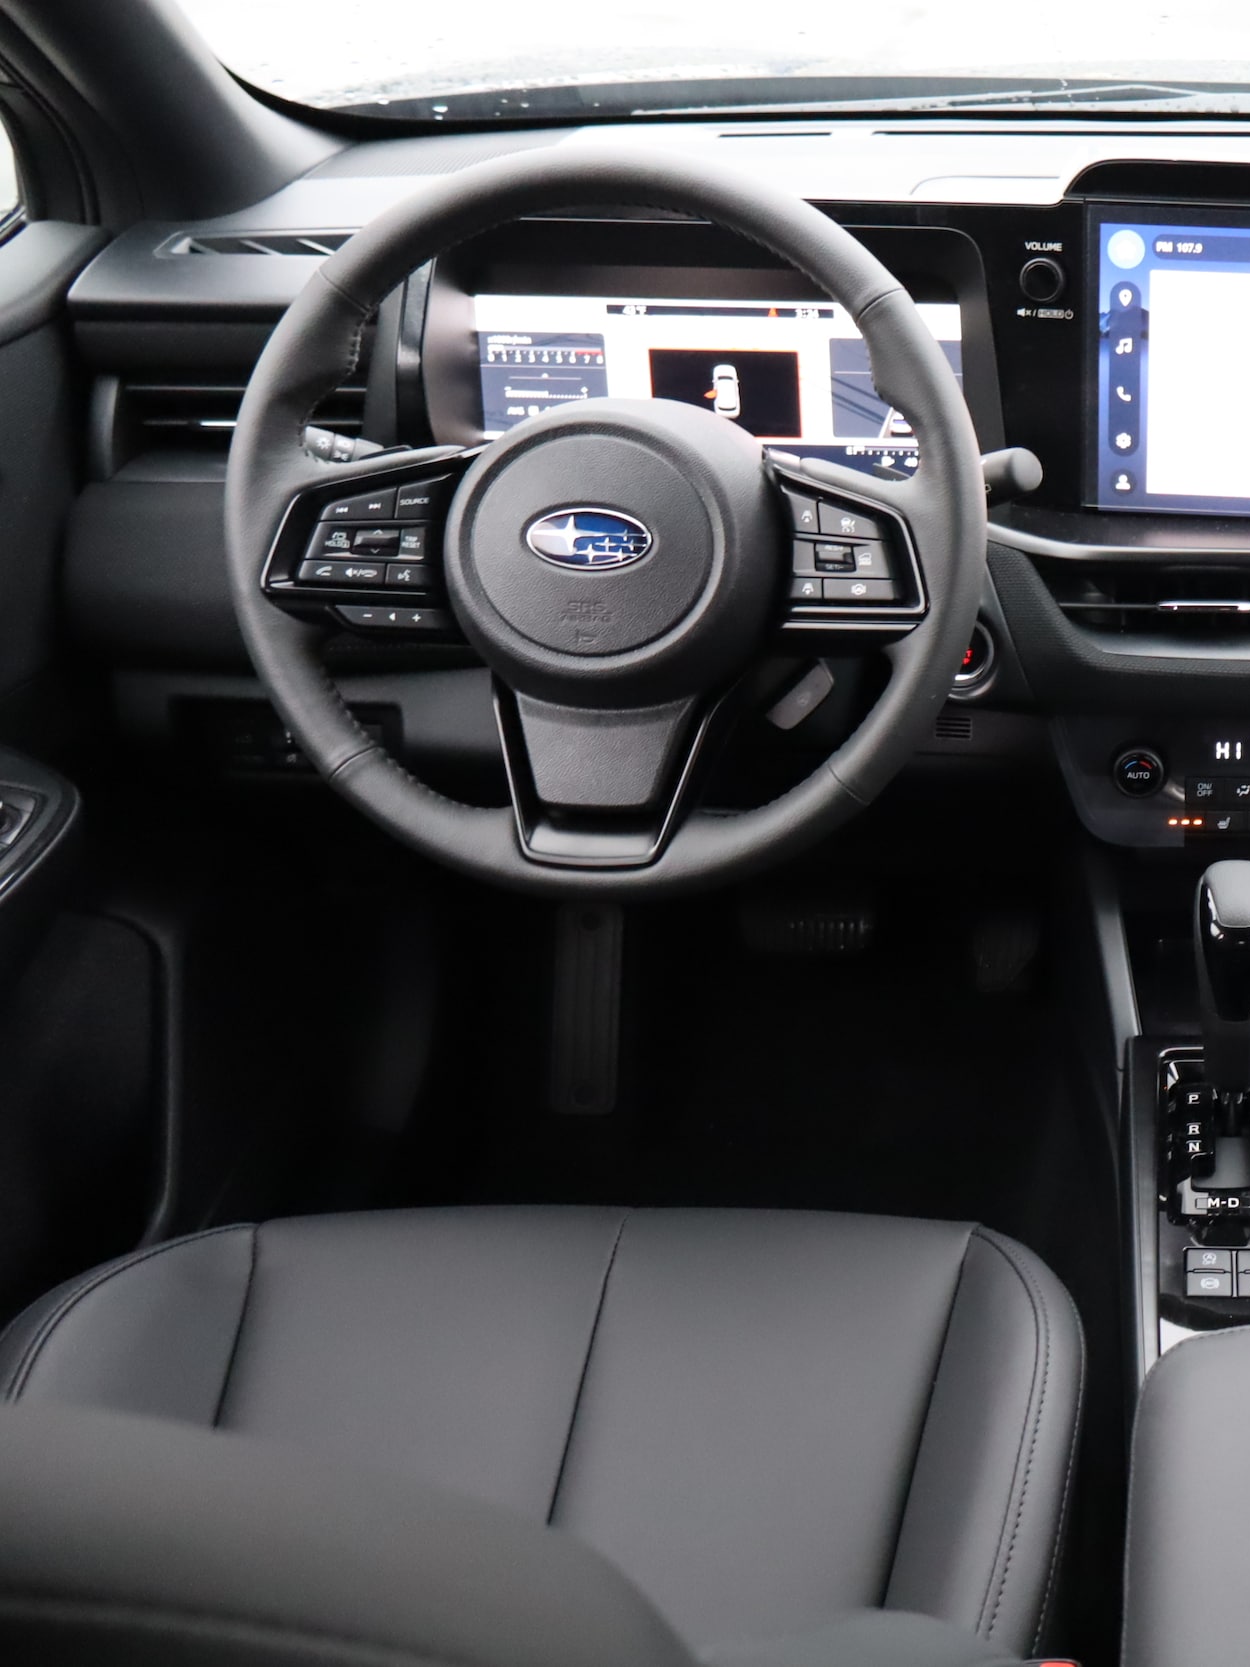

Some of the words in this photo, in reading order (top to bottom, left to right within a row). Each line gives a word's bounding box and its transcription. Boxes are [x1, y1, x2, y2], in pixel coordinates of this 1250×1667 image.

[1024, 241, 1063, 252] VOLUME
[1155, 241, 1173, 253] FM
[1176, 242, 1203, 254] 107.9
[400, 497, 430, 505] SOURCE
[1127, 771, 1150, 780] AUTO
[1188, 1093, 1199, 1104] P
[1188, 1124, 1200, 1135] R
[1188, 1142, 1200, 1152] N
